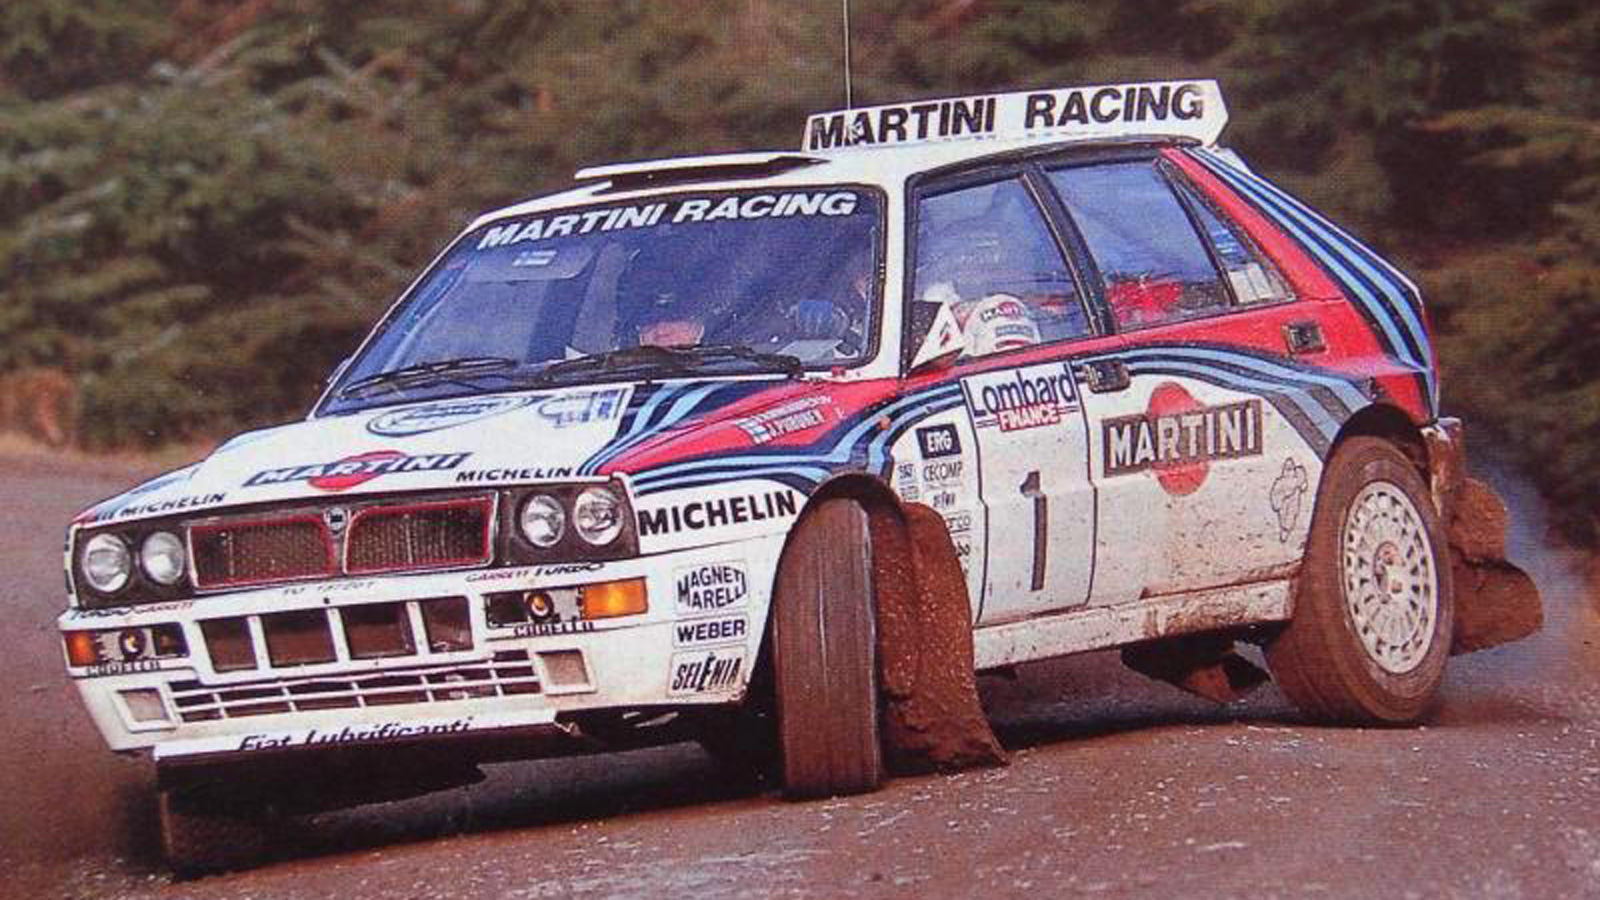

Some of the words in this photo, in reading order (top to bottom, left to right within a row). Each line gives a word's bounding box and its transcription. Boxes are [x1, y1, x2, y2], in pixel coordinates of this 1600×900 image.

[808, 95, 997, 152] MARTINI
[1024, 83, 1203, 130] RACING
[477, 205, 663, 250] MARTINI
[673, 191, 857, 224] RACING
[963, 363, 1077, 417] Lombard
[998, 401, 1060, 431] FINANCE
[927, 429, 953, 453] ERG
[1108, 406, 1256, 471] MARTINI
[243, 452, 472, 487] MARTINI
[455, 465, 572, 483] MICHELIN
[923, 461, 963, 483] CECOMP
[119, 492, 226, 518] MICHELIN
[638, 489, 798, 537] MICHELIN
[1019, 470, 1049, 592] 1
[677, 618, 746, 643] WEBER
[239, 734, 292, 750] Fiat
[305, 716, 474, 745] Lubrificanti
